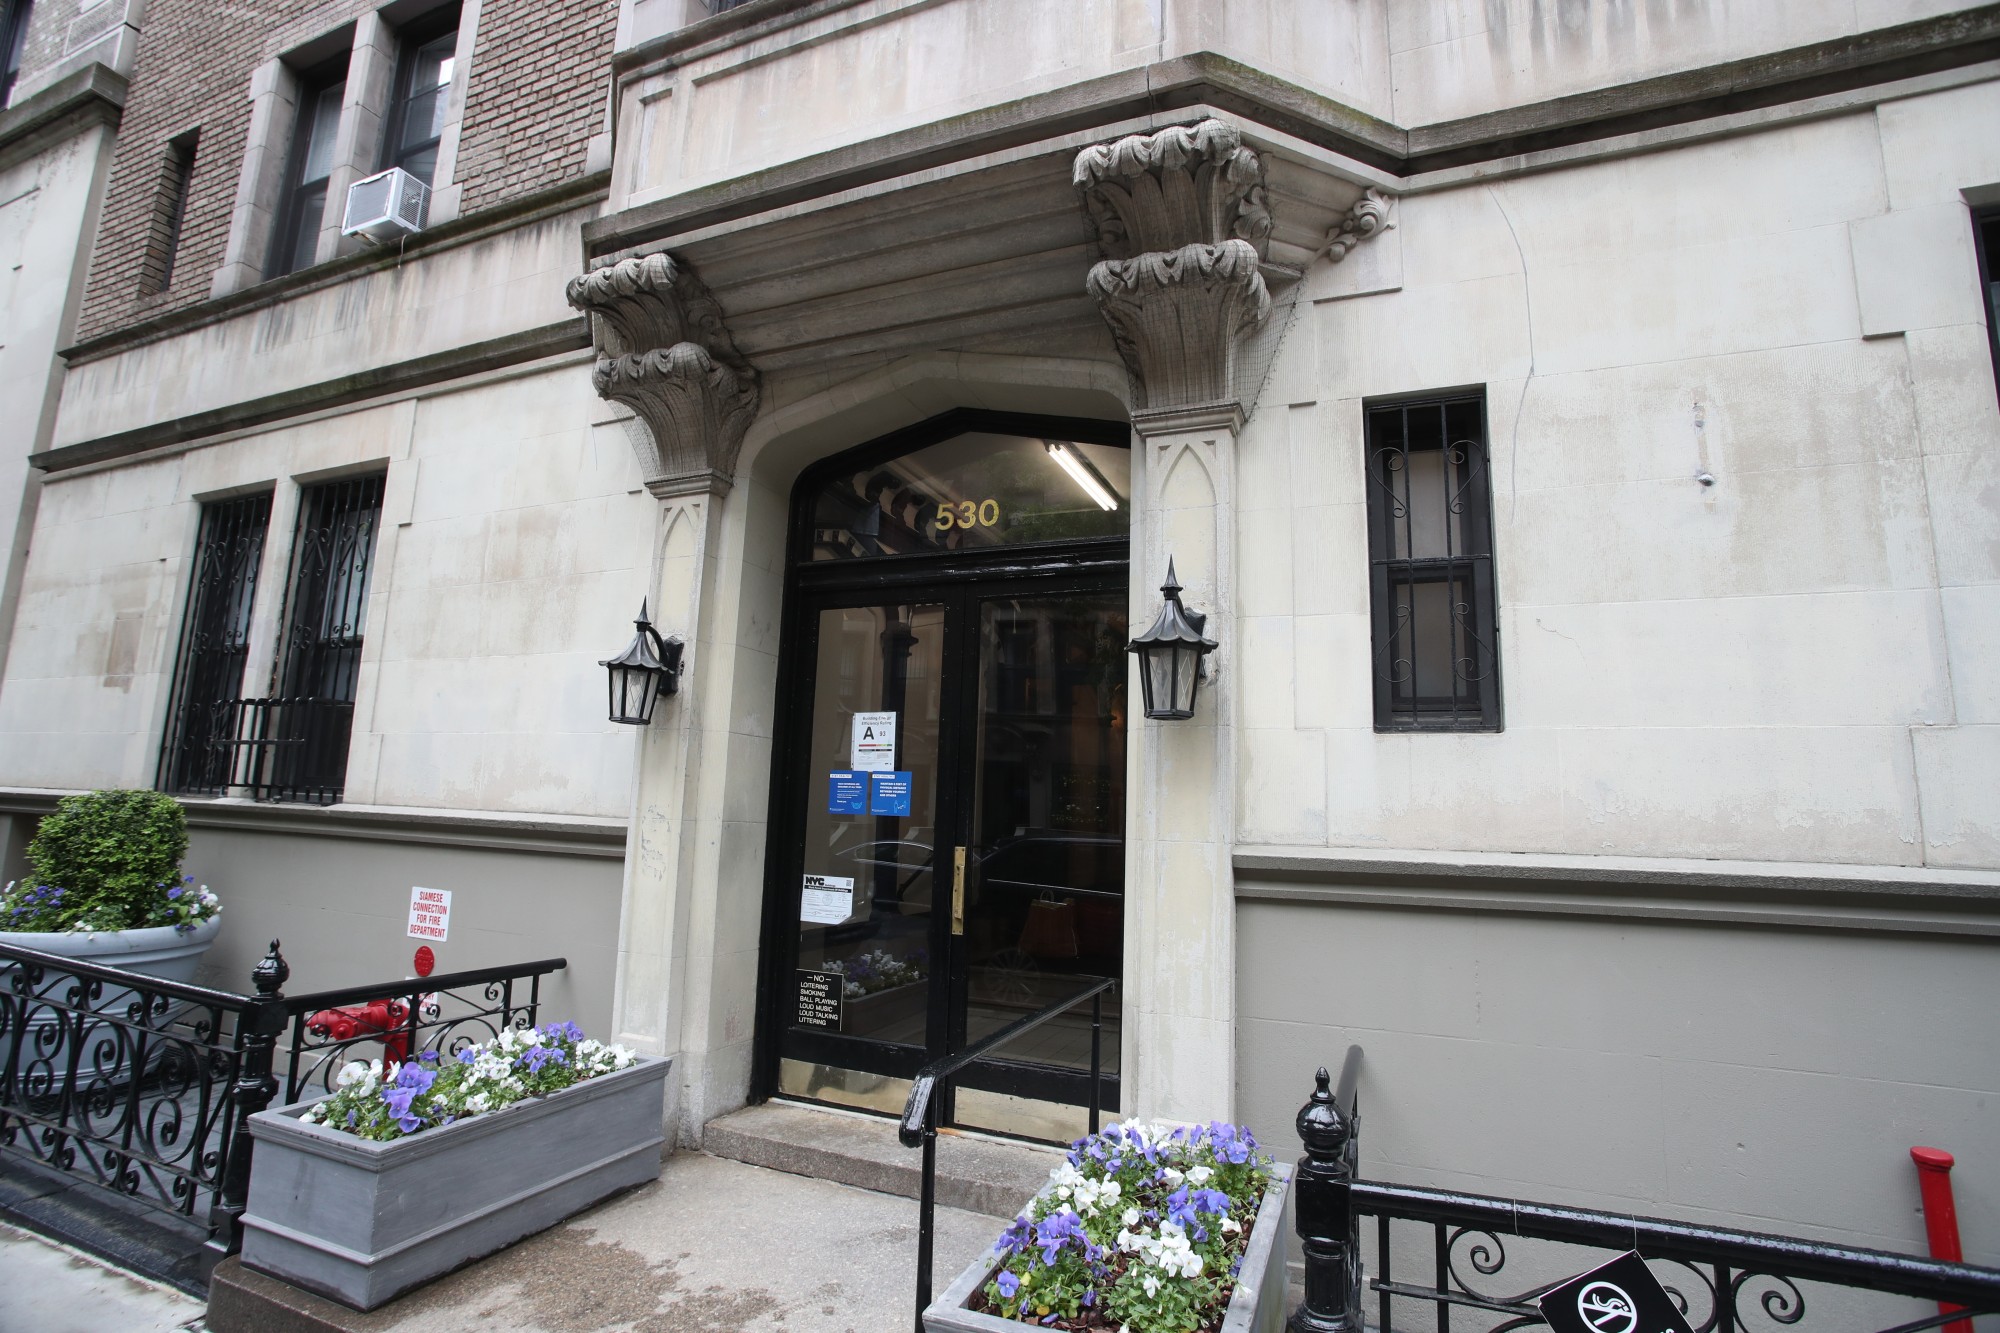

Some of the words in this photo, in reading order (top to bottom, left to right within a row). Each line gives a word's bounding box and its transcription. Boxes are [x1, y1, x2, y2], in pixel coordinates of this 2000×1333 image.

[934, 499, 999, 531] 530
[863, 726, 874, 740] A
[805, 876, 824, 885] NYC
[419, 891, 443, 903] SIAMESE
[413, 902, 447, 915] CONNECTION
[416, 914, 427, 924] FOR
[429, 916, 441, 925] FIRE
[410, 924, 445, 938] DEPARTMENT
[800, 982, 828, 990] LOITERING
[800, 989, 825, 997] SMOKING
[798, 1016, 826, 1025] LITTERING
[815, 1012, 838, 1020] TALKING
